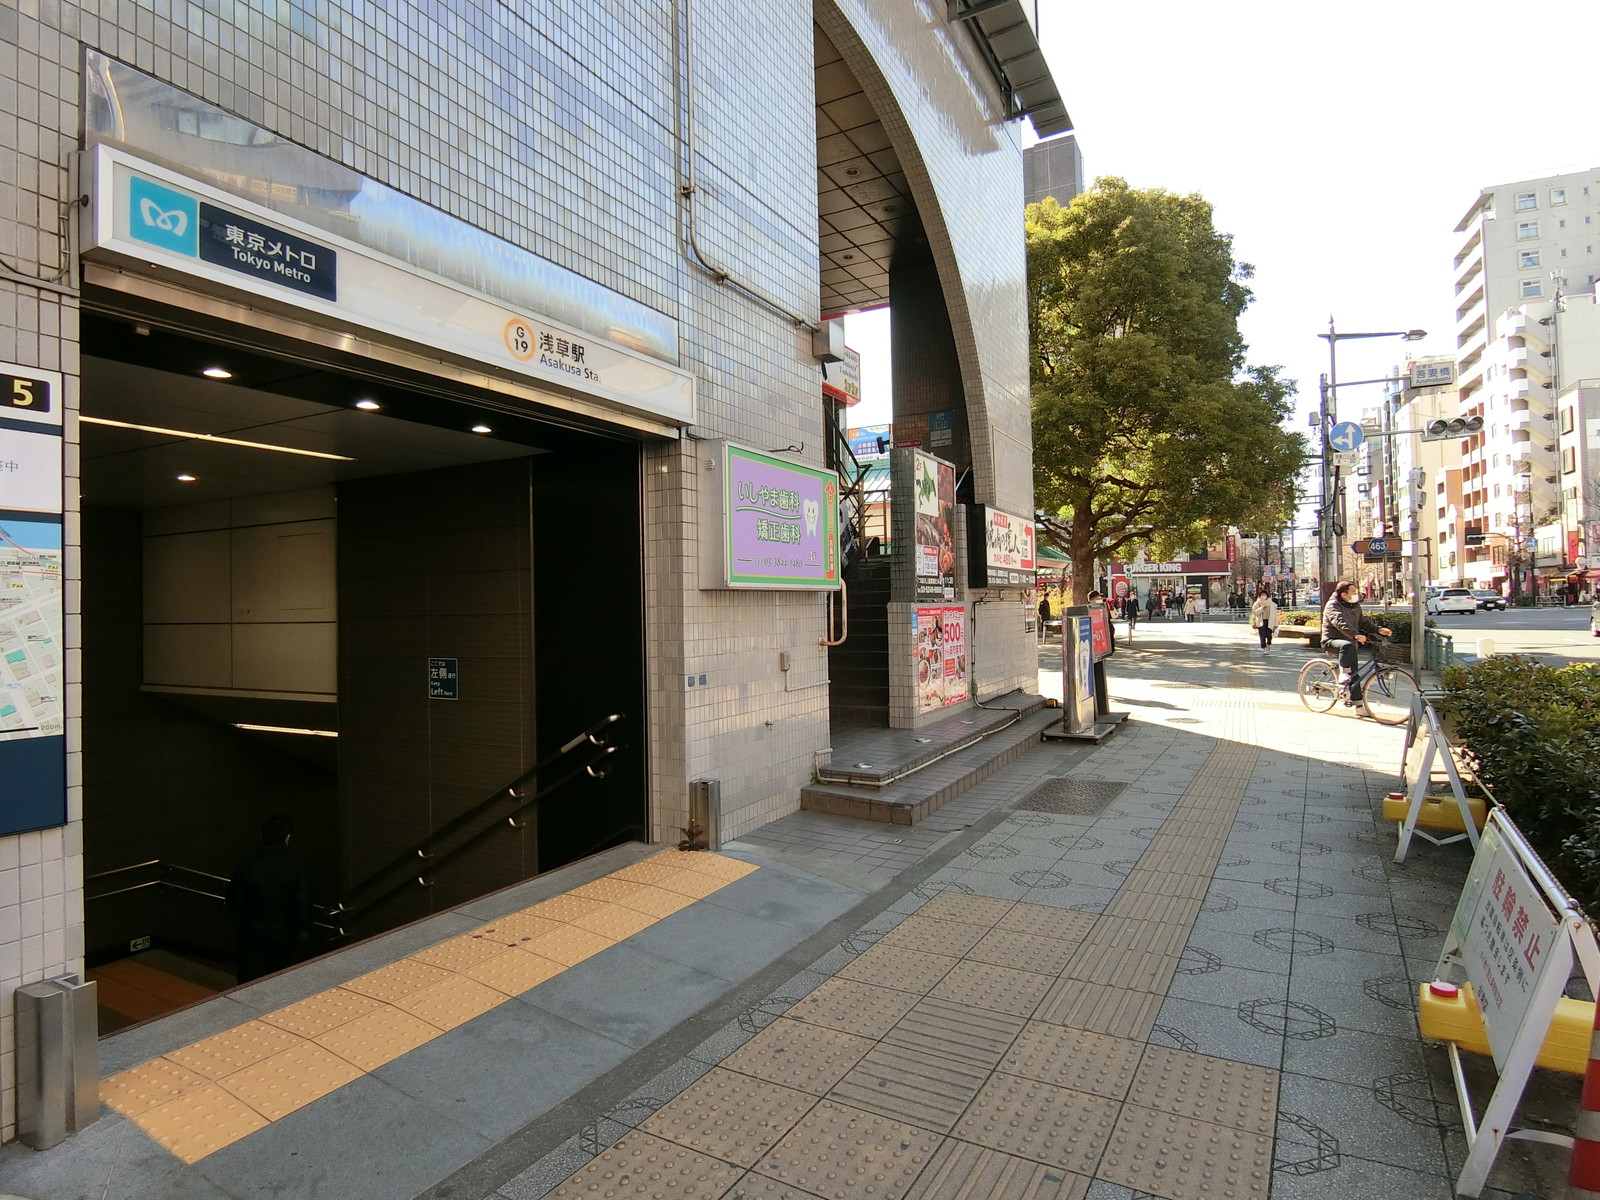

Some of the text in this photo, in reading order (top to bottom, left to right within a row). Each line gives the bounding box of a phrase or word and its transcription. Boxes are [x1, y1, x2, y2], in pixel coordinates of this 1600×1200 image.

[225, 224, 316, 270] 東京メトロ
[231, 246, 311, 283] Tokyo Metro
[516, 326, 525, 339] G
[515, 339, 528, 353] 19
[540, 331, 585, 364] 浅草駅
[540, 354, 602, 383] Asakusa Sta.
[1416, 367, 1450, 379] 吾妻橋
[13, 380, 34, 406] 5
[738, 480, 801, 513] いしやま歯科
[757, 518, 801, 545] 矯正歯科
[1370, 541, 1386, 550] 463
[1159, 563, 1182, 572] KING
[431, 688, 443, 696] Left
[1492, 868, 1541, 972] 駐輪禁止
